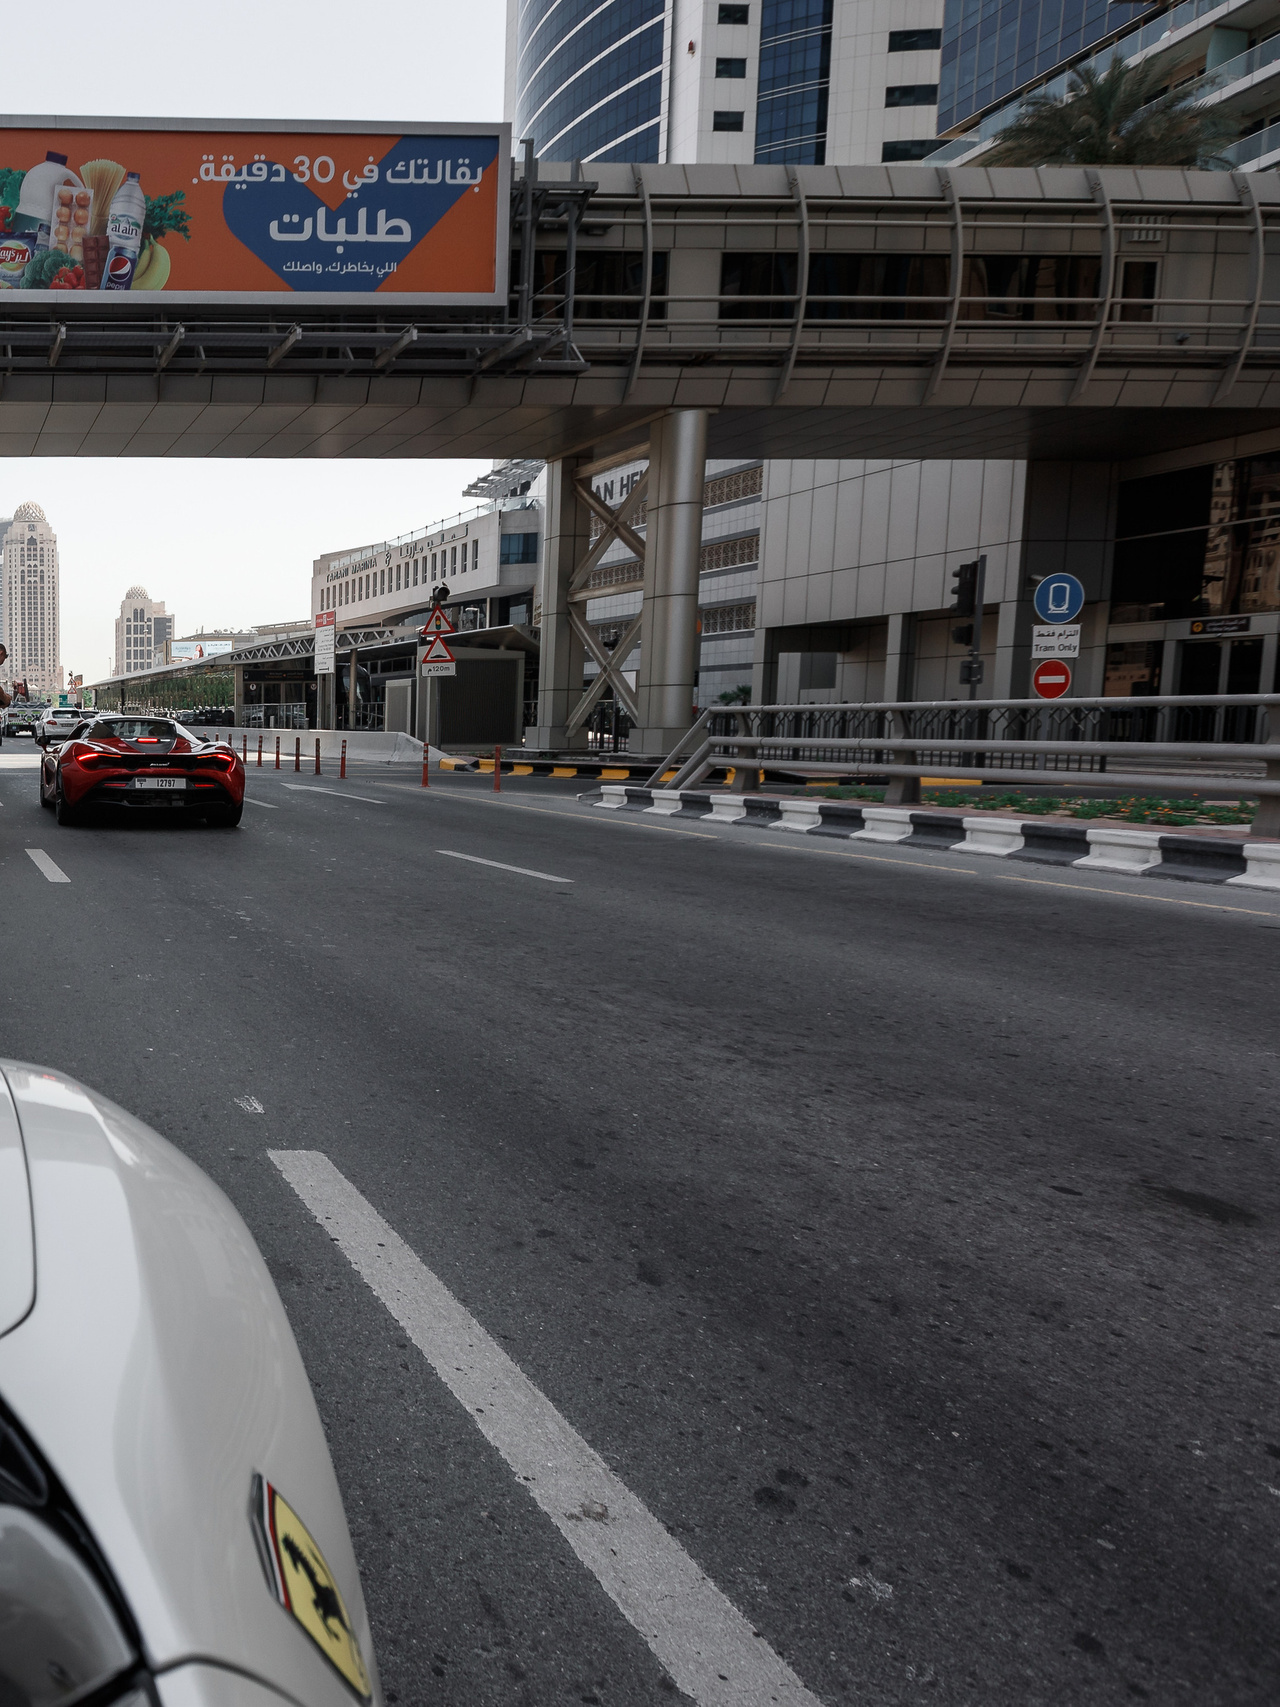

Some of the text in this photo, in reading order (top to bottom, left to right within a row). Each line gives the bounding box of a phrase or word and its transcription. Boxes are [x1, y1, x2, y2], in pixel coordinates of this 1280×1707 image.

[192, 154, 483, 198] بقالتك في 30 دقيقة.
[269, 206, 412, 254] طلبات
[283, 261, 323, 274] واصلك
[376, 262, 397, 278] اللي
[106, 281, 126, 290] pepsi
[620, 469, 643, 498] HE
[326, 557, 377, 583] TAMANI MARINA
[1035, 629, 1079, 640] الترام فقط
[1034, 643, 1078, 653] Tram Only
[156, 779, 176, 788] 12797
